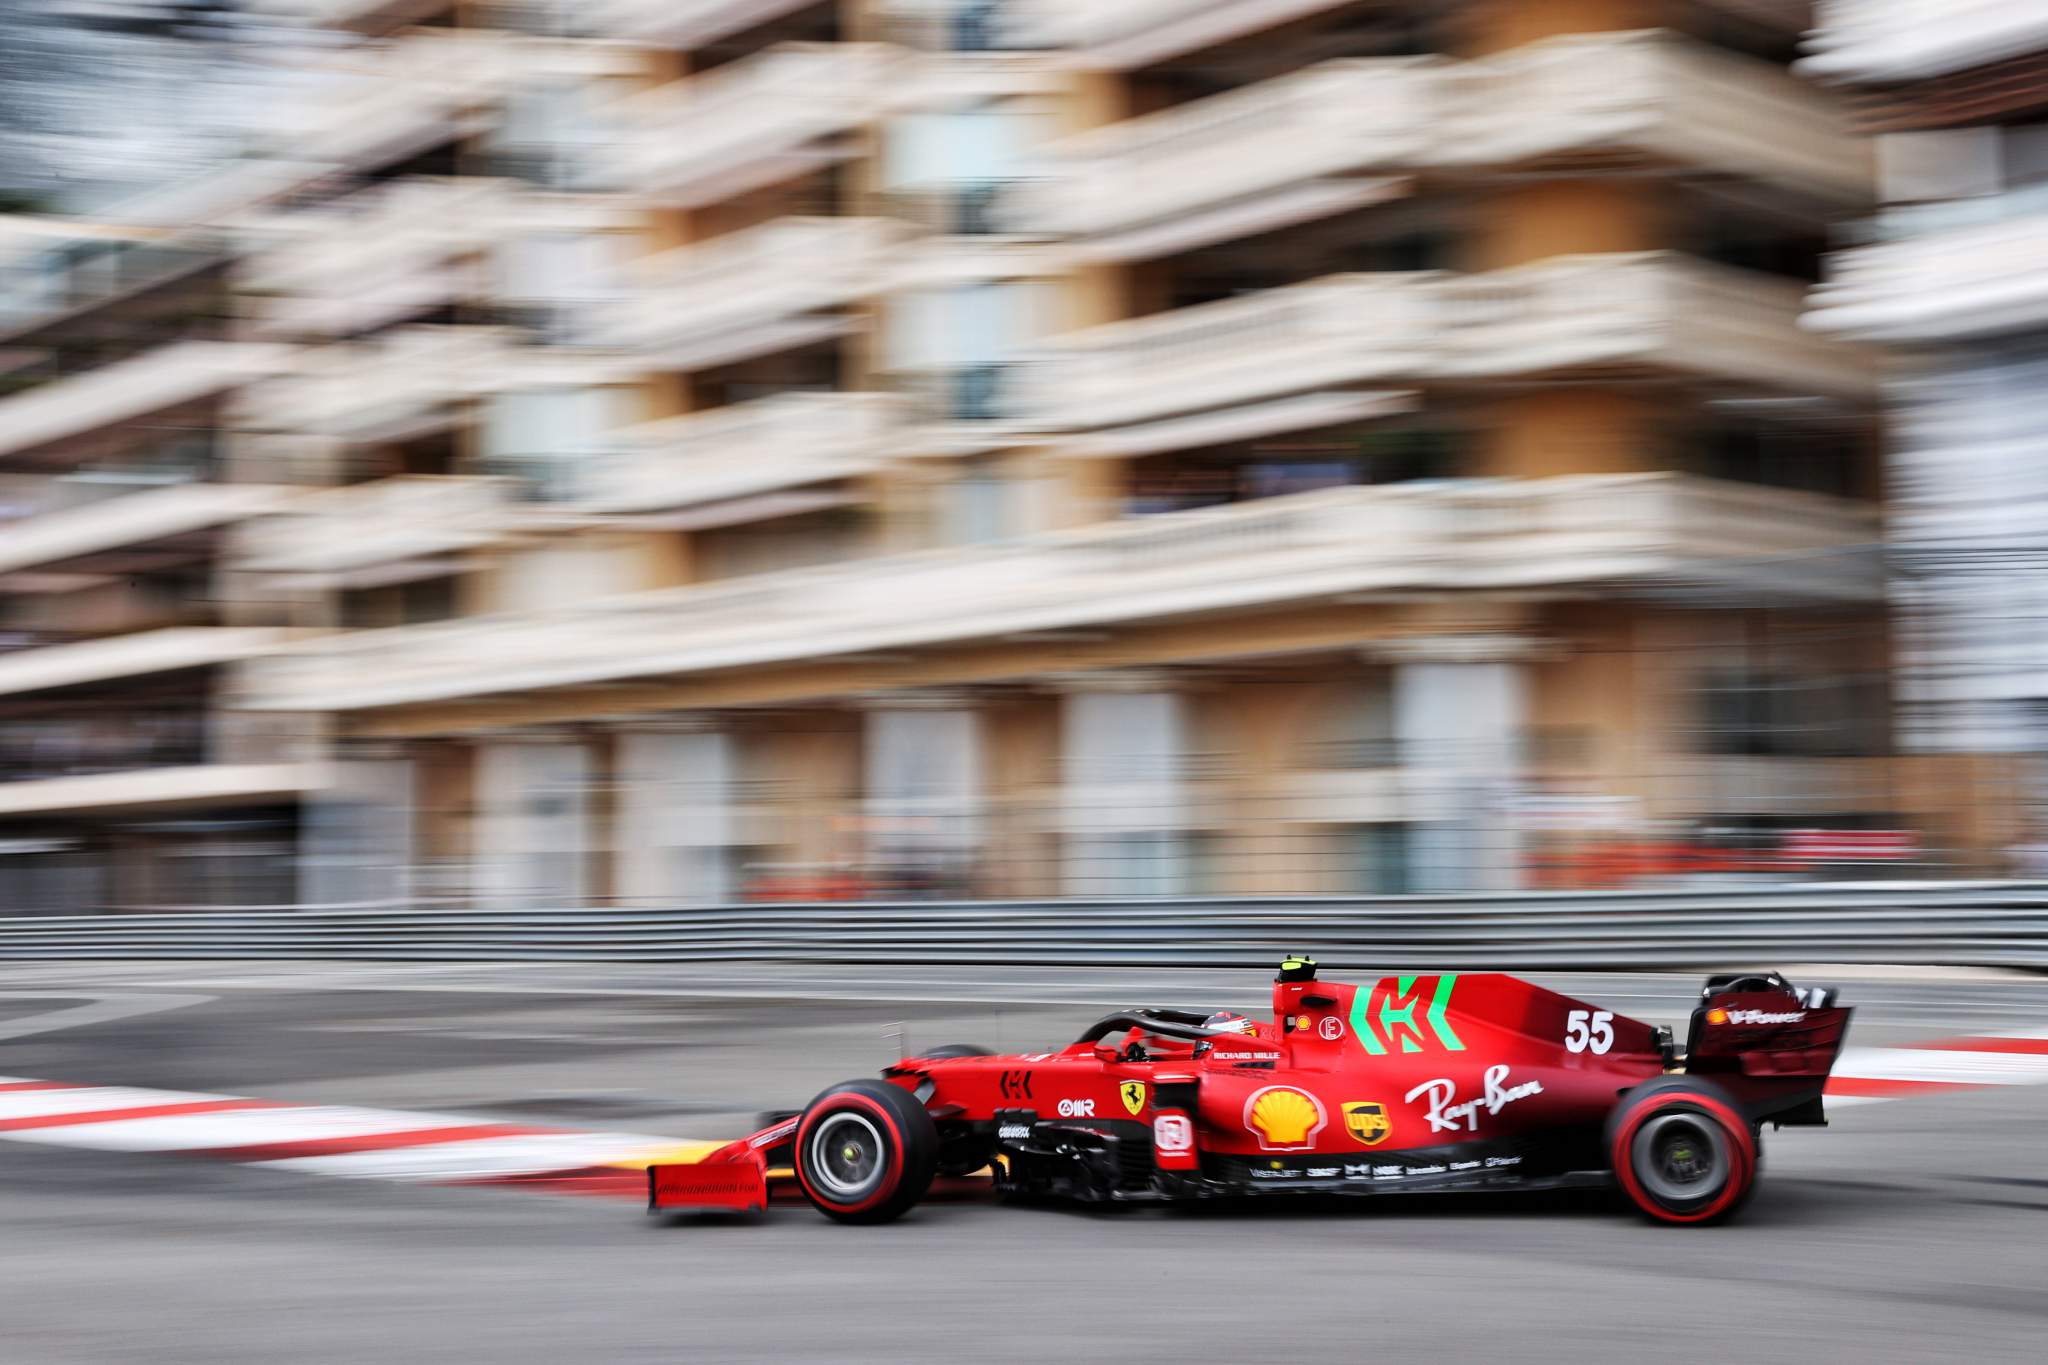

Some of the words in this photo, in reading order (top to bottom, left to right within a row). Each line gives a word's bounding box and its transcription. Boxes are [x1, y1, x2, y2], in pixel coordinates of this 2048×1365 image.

[1564, 1010, 1614, 1055] 55
[1213, 1052, 1252, 1060] RICHARD
[1253, 1052, 1281, 1060] MILLE
[1405, 1064, 1544, 1133] Ray-Ban
